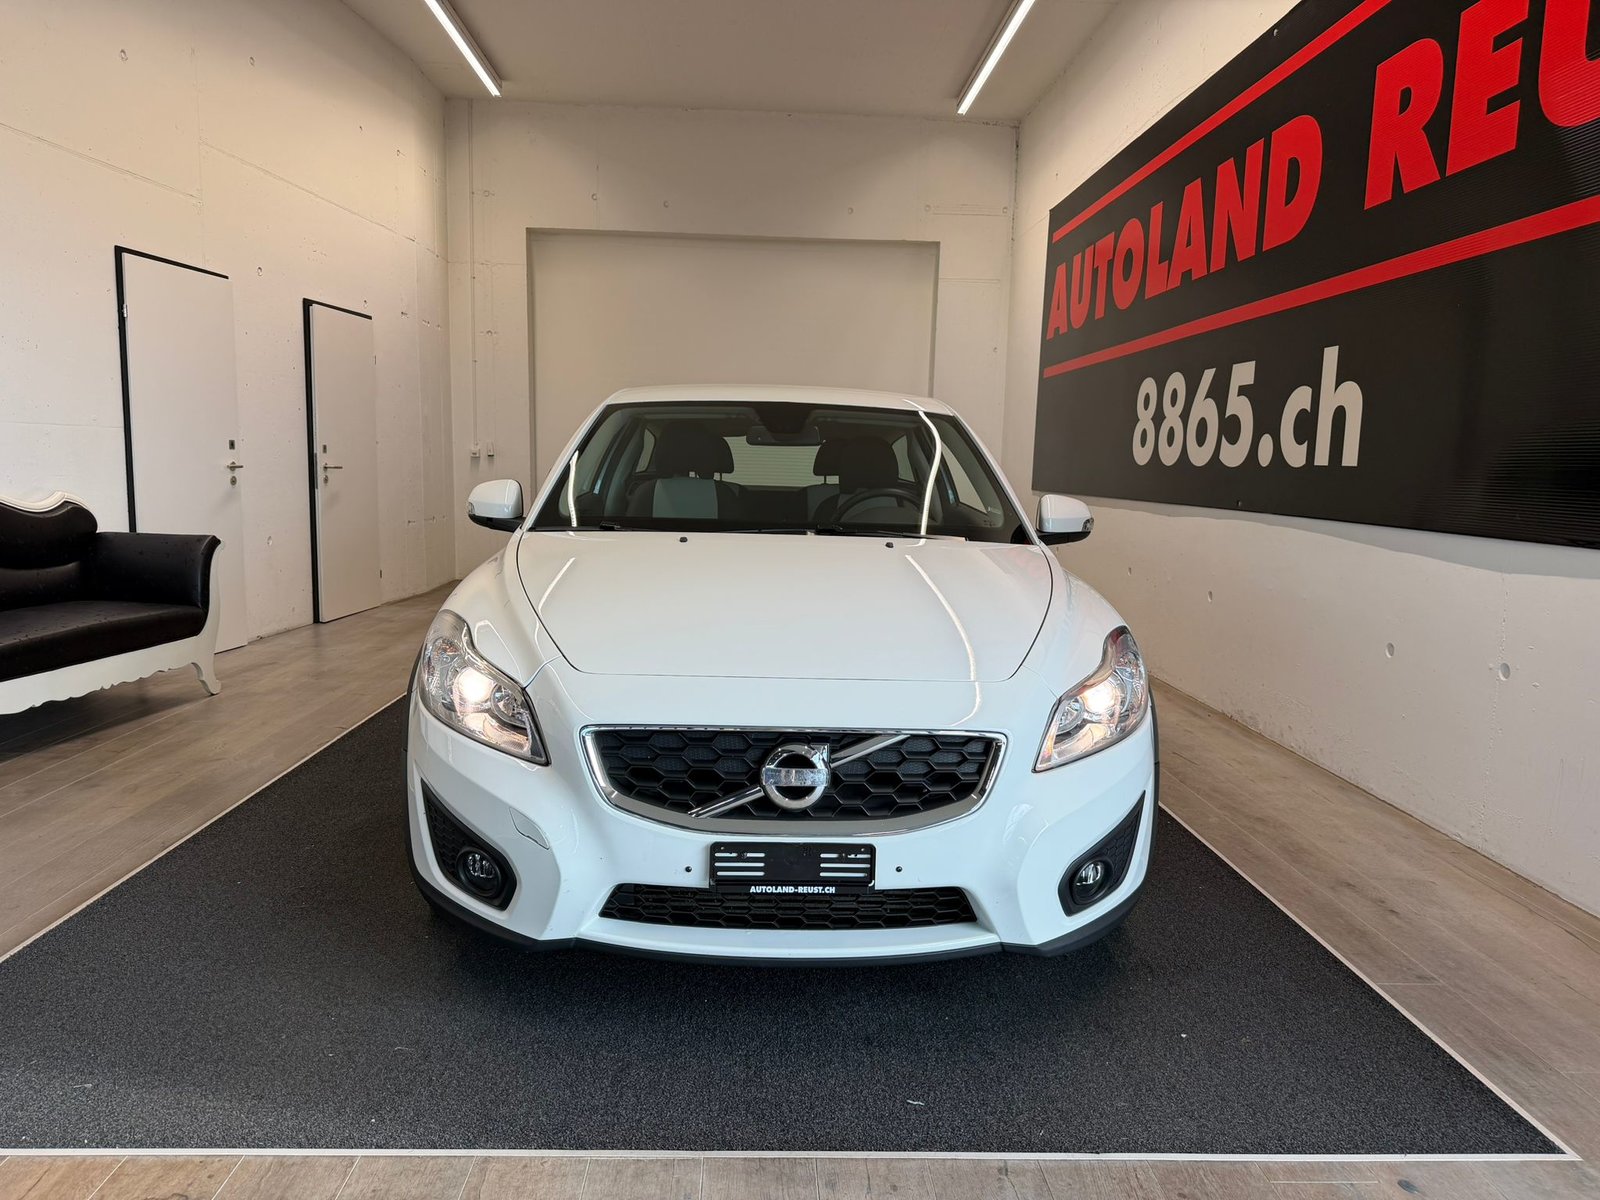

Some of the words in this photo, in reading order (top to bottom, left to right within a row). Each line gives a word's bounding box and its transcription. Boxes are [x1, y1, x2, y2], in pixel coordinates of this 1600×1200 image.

[1046, 114, 1323, 340] AUTOLAND
[1132, 345, 1364, 468] 8865.ch
[750, 885, 836, 894] AUTOLAND-REUST.CH
